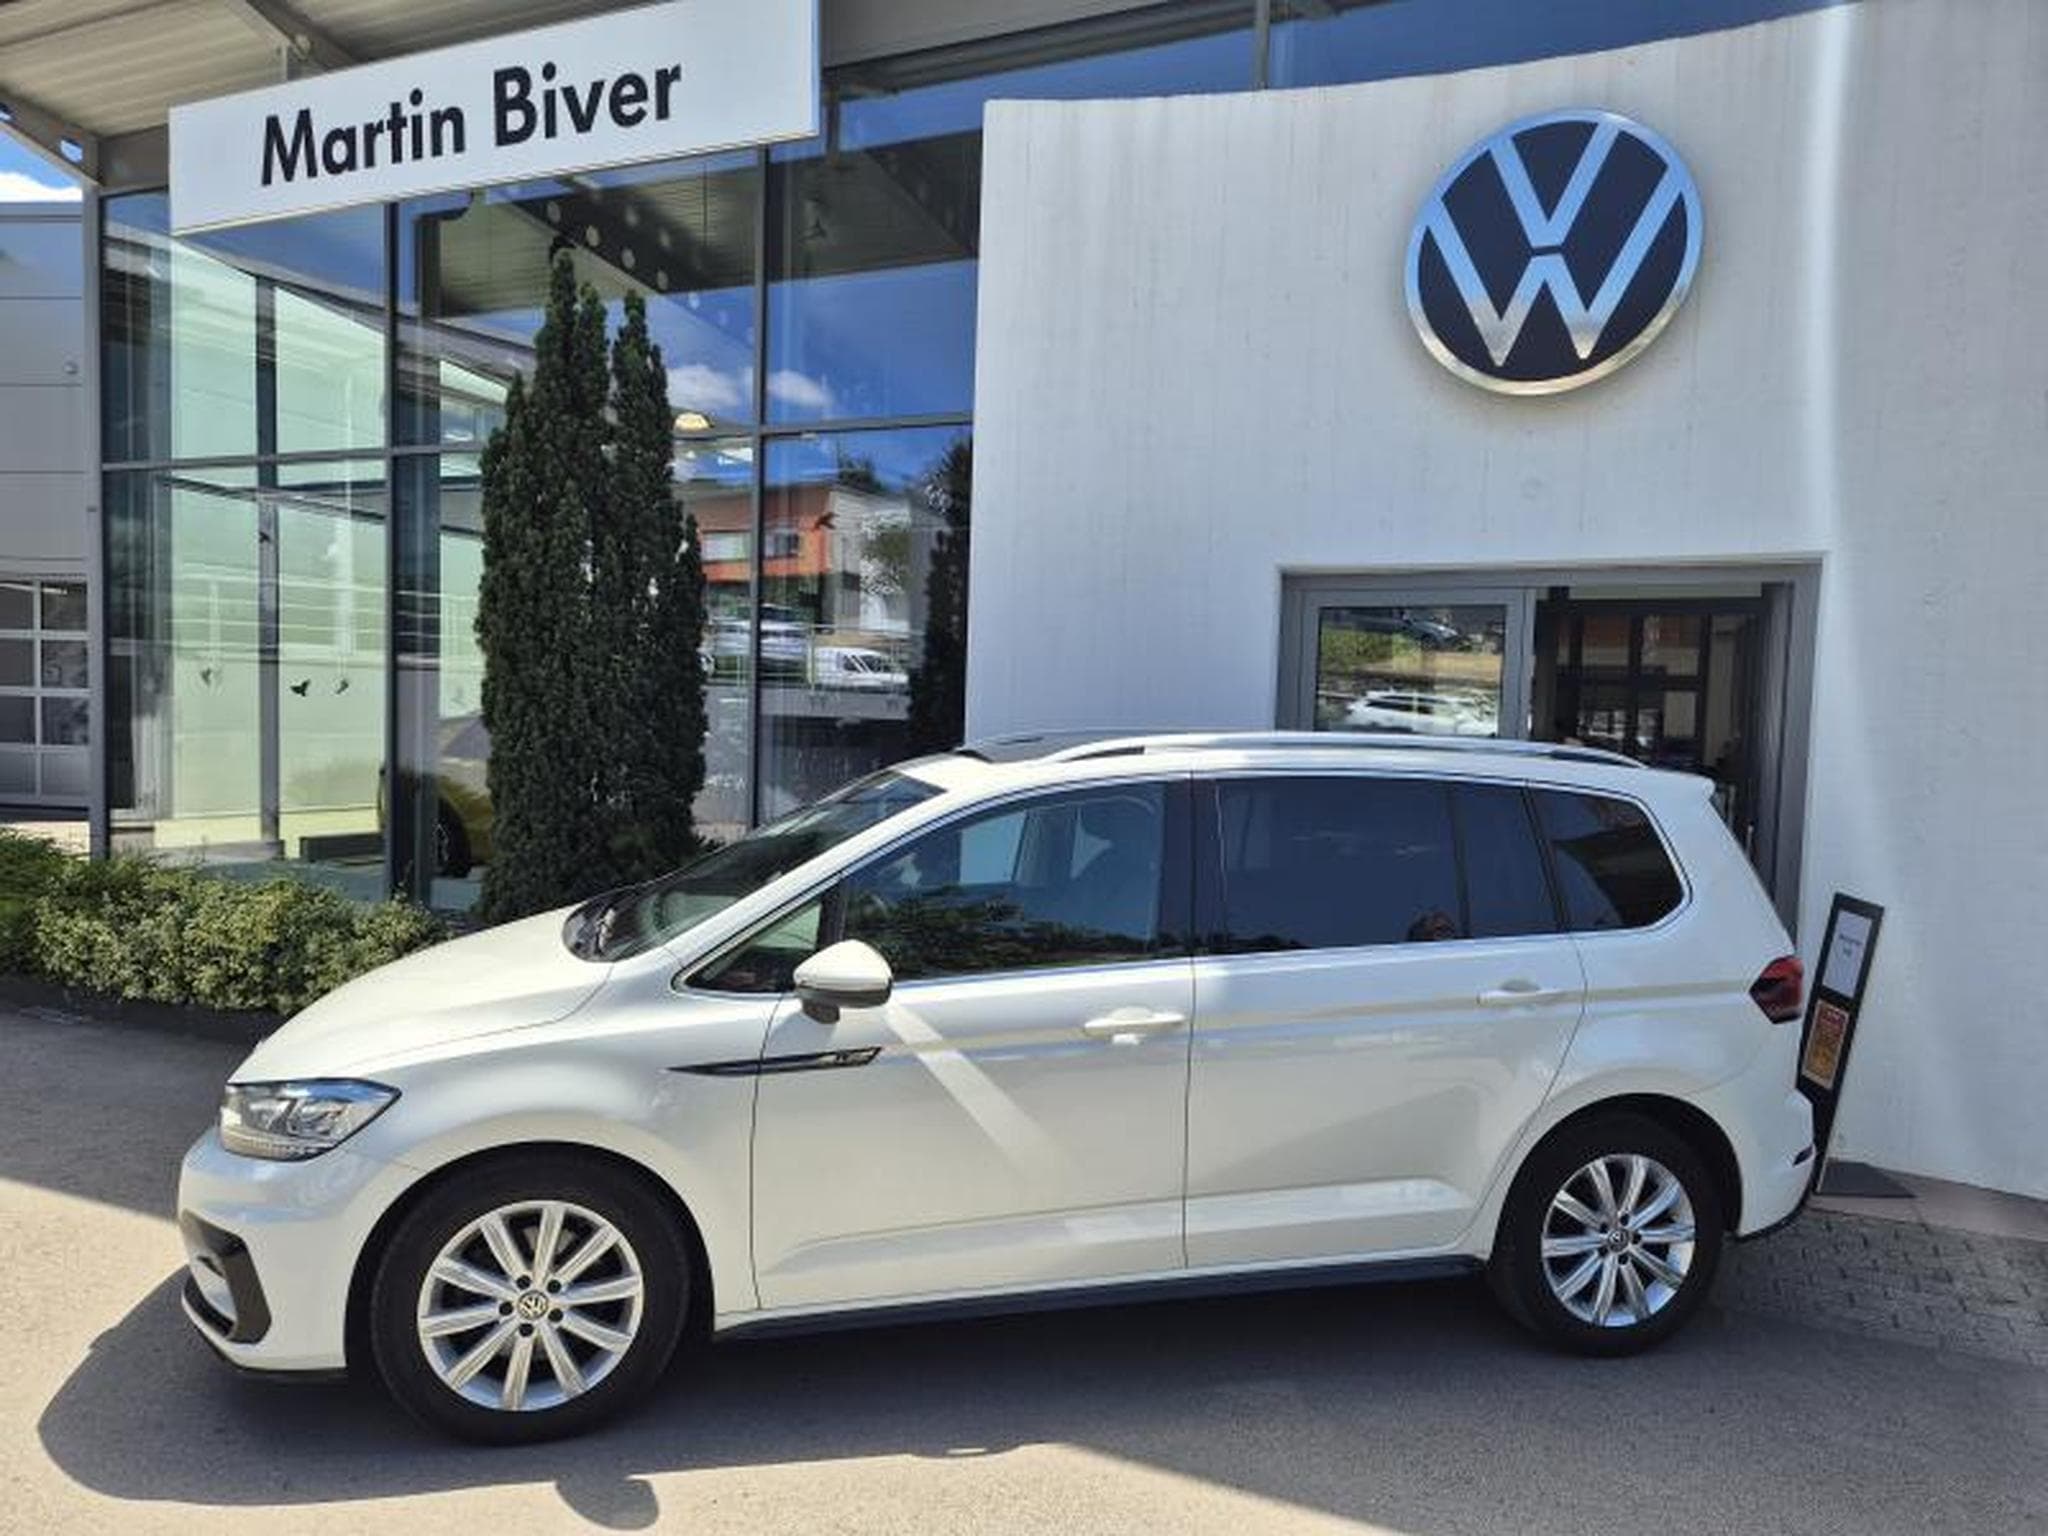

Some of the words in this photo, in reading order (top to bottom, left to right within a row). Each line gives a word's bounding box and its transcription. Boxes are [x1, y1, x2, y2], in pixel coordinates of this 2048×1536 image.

[261, 87, 465, 186] Martin
[492, 61, 682, 147] Biver
[1417, 116, 1690, 370] VW
